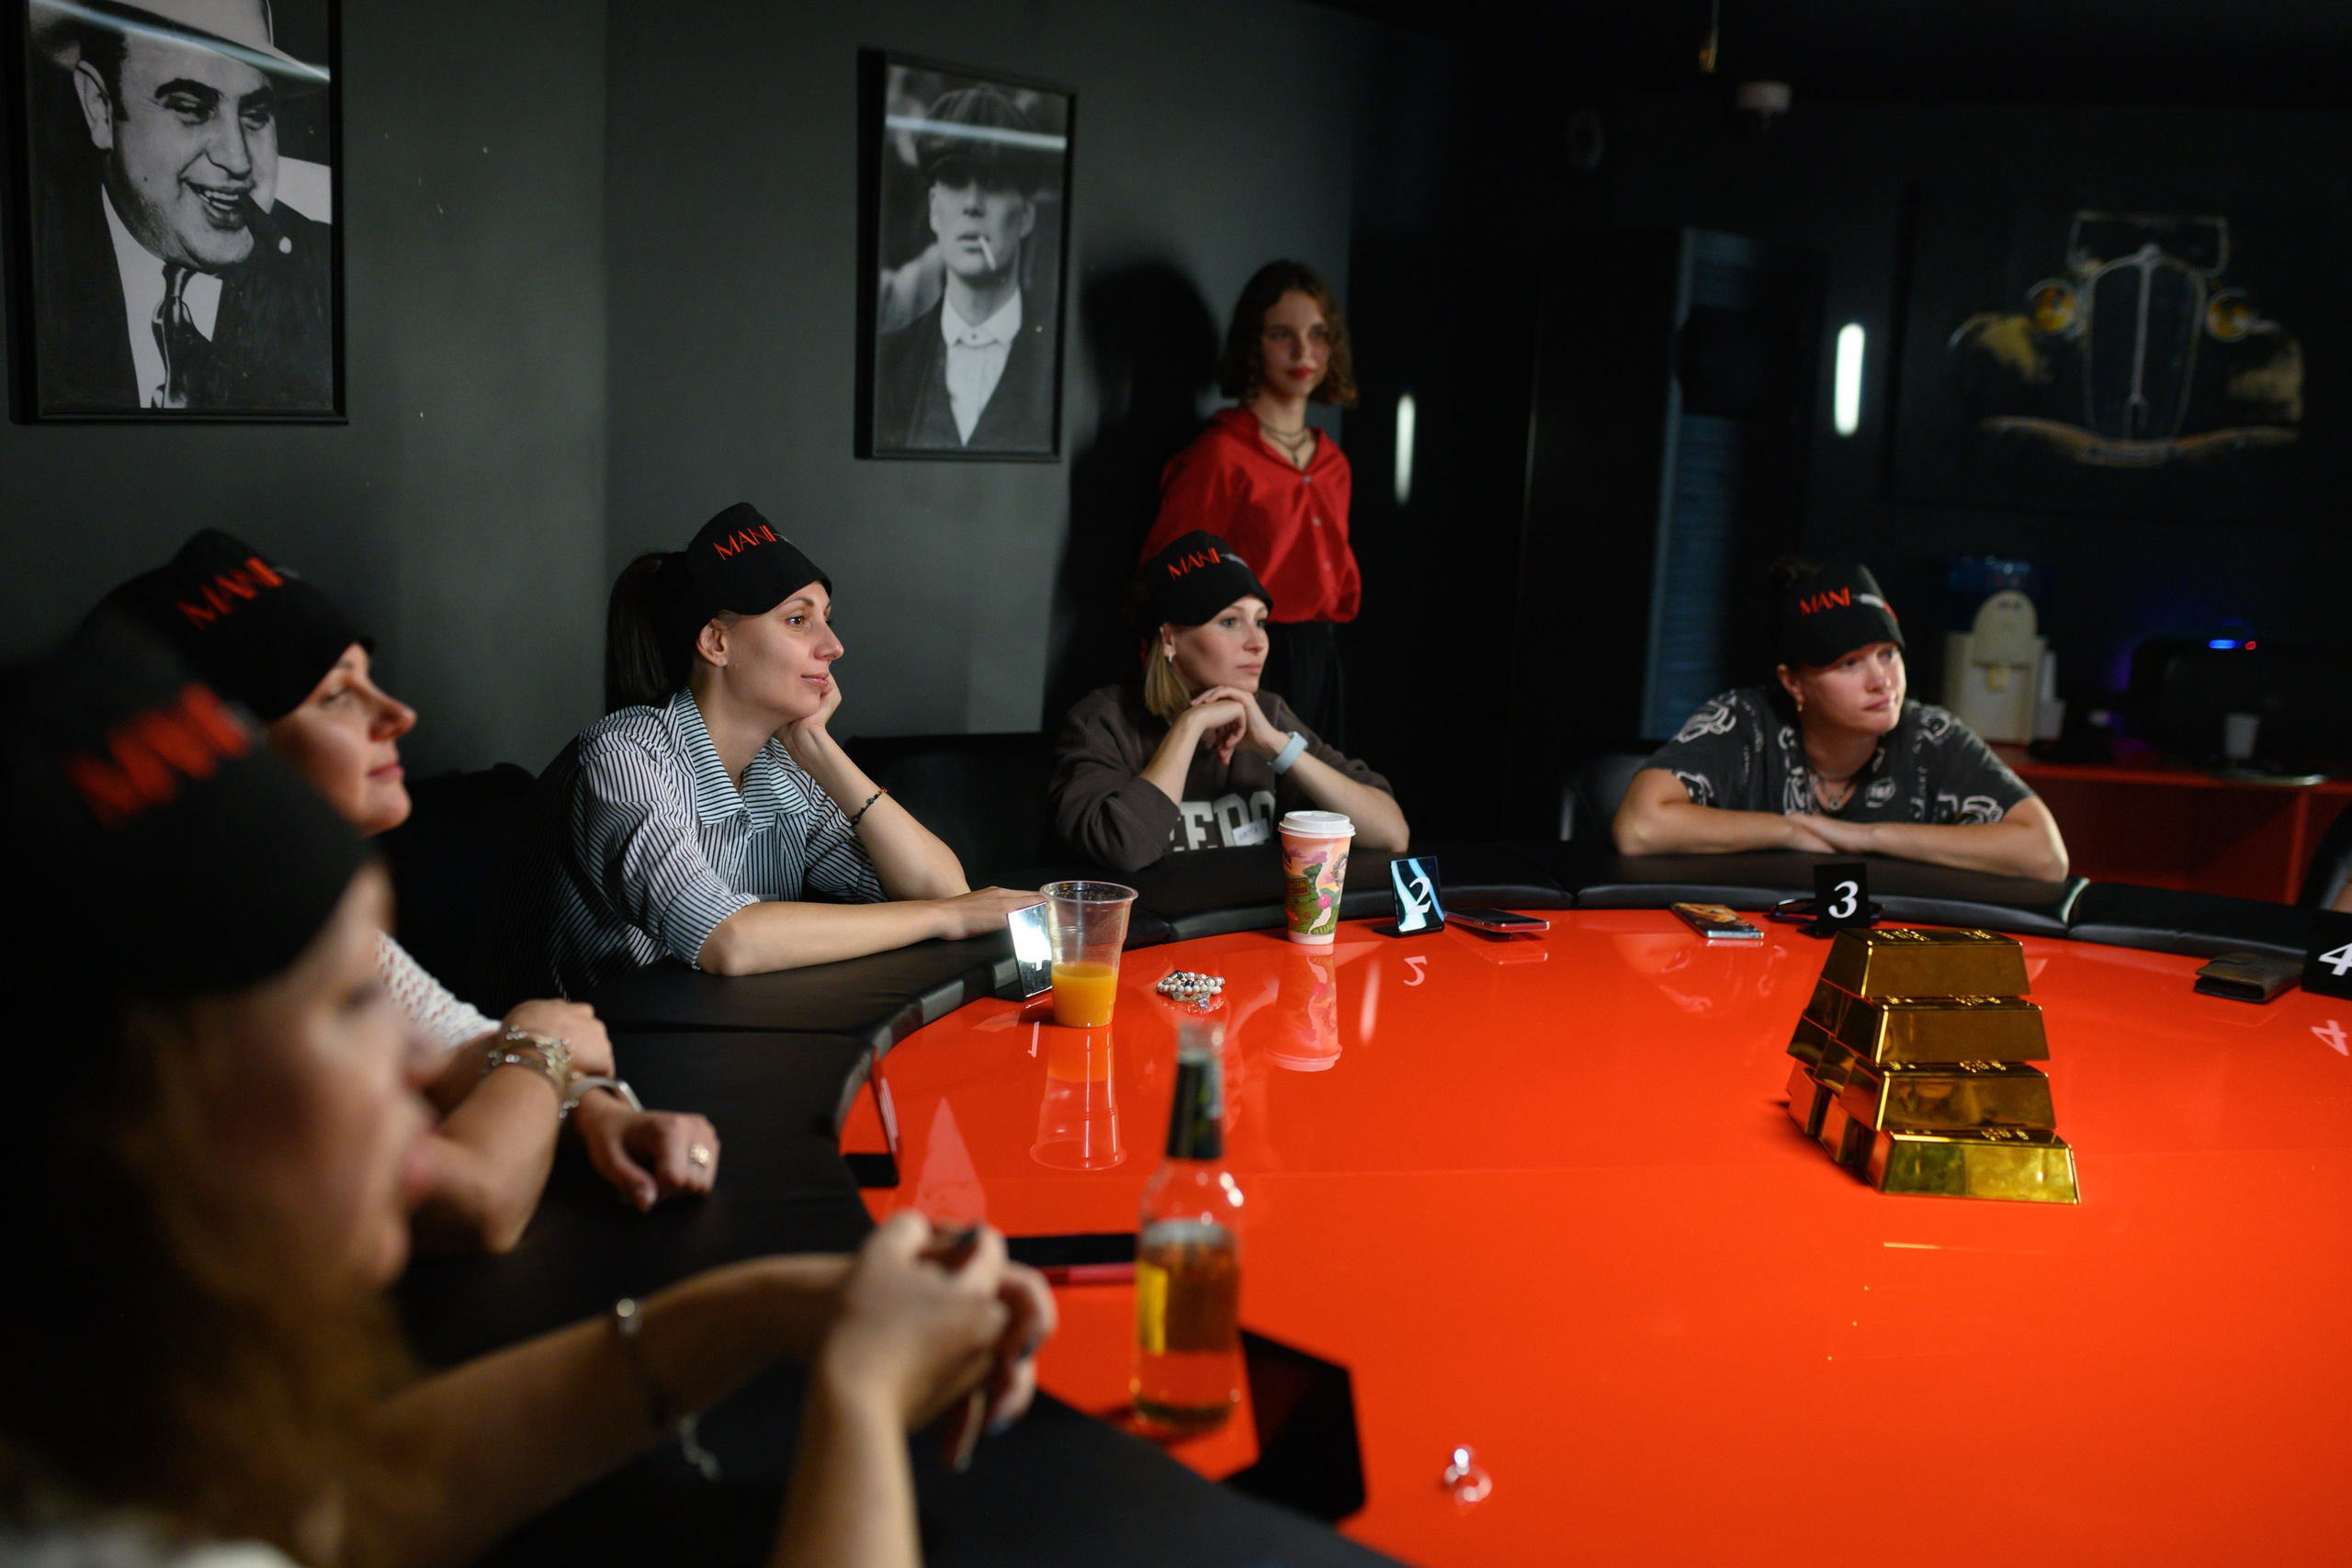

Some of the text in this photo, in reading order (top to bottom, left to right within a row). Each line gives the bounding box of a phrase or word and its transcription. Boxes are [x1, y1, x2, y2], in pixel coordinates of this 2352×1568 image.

[712, 525, 777, 560] MANI
[1167, 547, 1221, 581] MANI
[1799, 586, 1851, 617] MANI
[1407, 876, 1431, 915] 2
[1828, 880, 1859, 919] 3
[2318, 942, 2352, 976] 4
